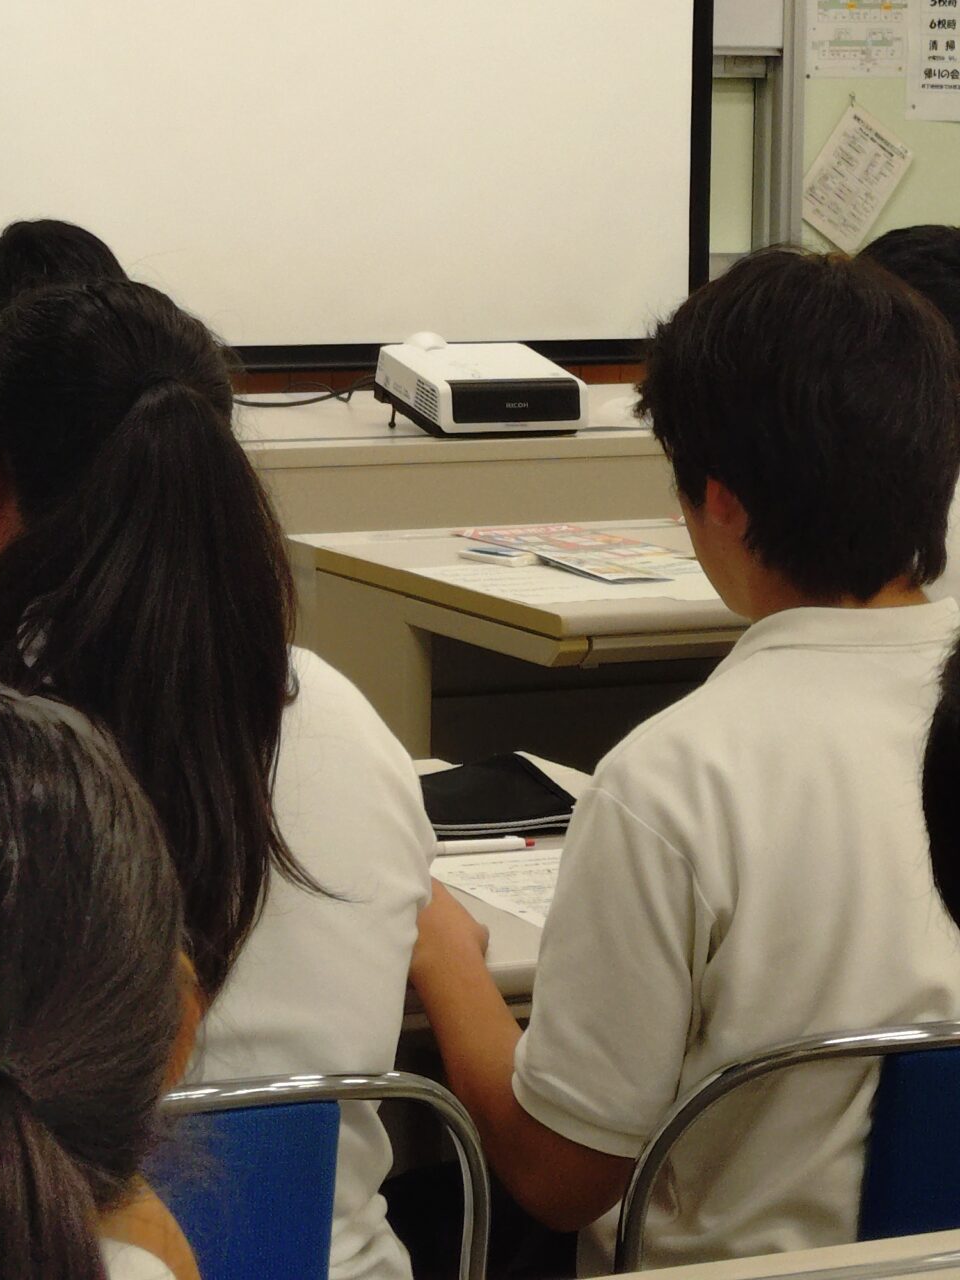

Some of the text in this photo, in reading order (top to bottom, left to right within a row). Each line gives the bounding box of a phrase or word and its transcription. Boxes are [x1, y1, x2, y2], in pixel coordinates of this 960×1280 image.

[929, 18, 957, 30] 6校時
[924, 67, 960, 80] 帰りの会
[505, 401, 529, 409] RICOH
